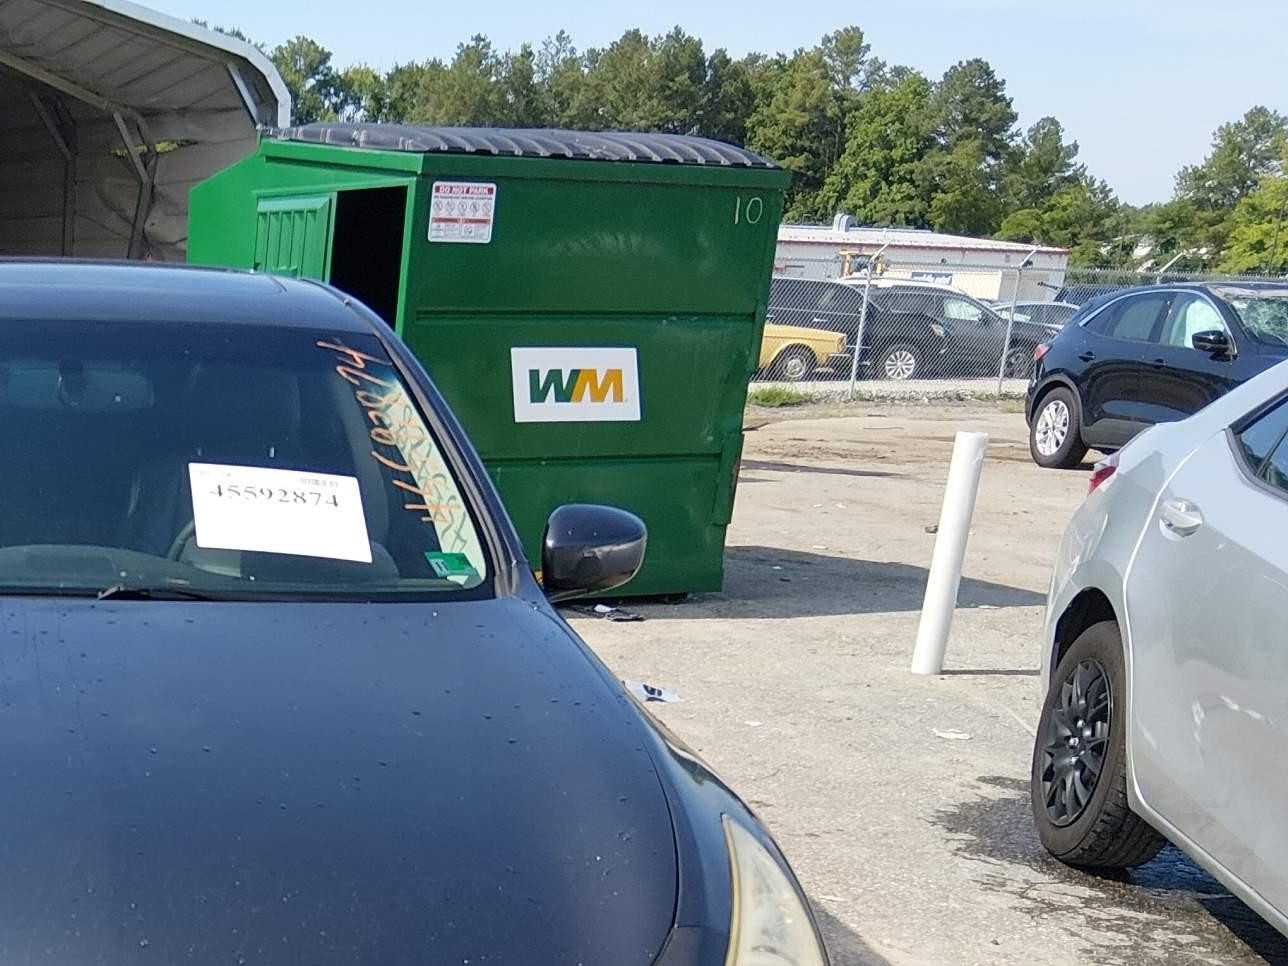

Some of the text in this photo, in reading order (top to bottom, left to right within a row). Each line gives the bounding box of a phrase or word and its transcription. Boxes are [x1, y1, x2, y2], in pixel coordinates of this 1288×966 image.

[734, 196, 763, 225] 10
[528, 368, 624, 404] WM
[210, 484, 340, 508] 45592874
